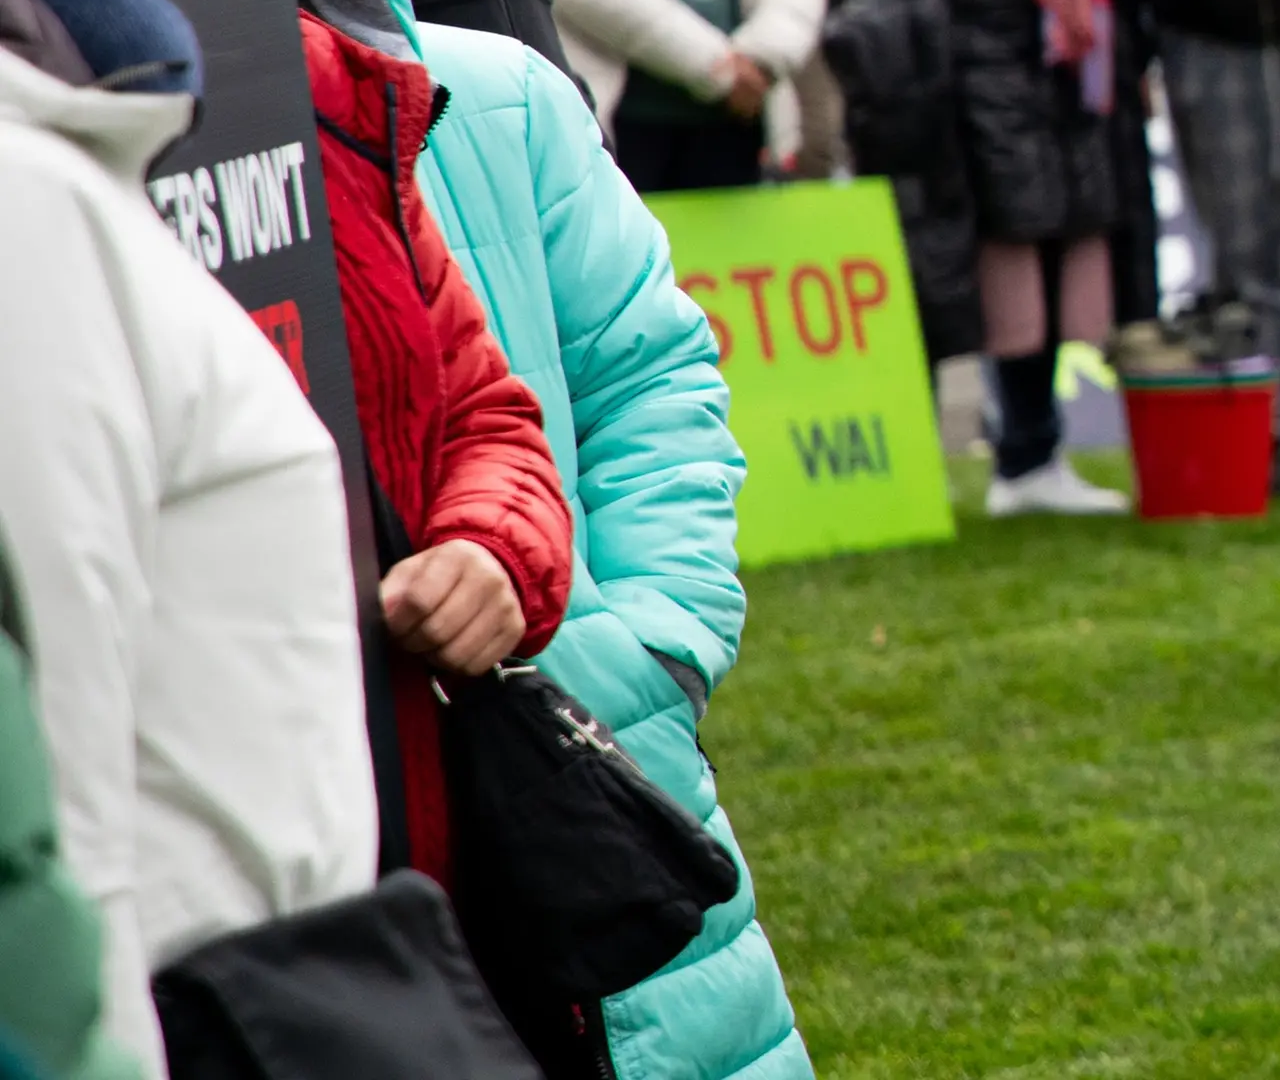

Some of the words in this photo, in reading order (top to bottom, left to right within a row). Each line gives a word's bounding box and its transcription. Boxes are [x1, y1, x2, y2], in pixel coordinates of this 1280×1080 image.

[214, 141, 311, 263] WON'T
[677, 258, 889, 370] STOP
[788, 413, 892, 484] WAI
